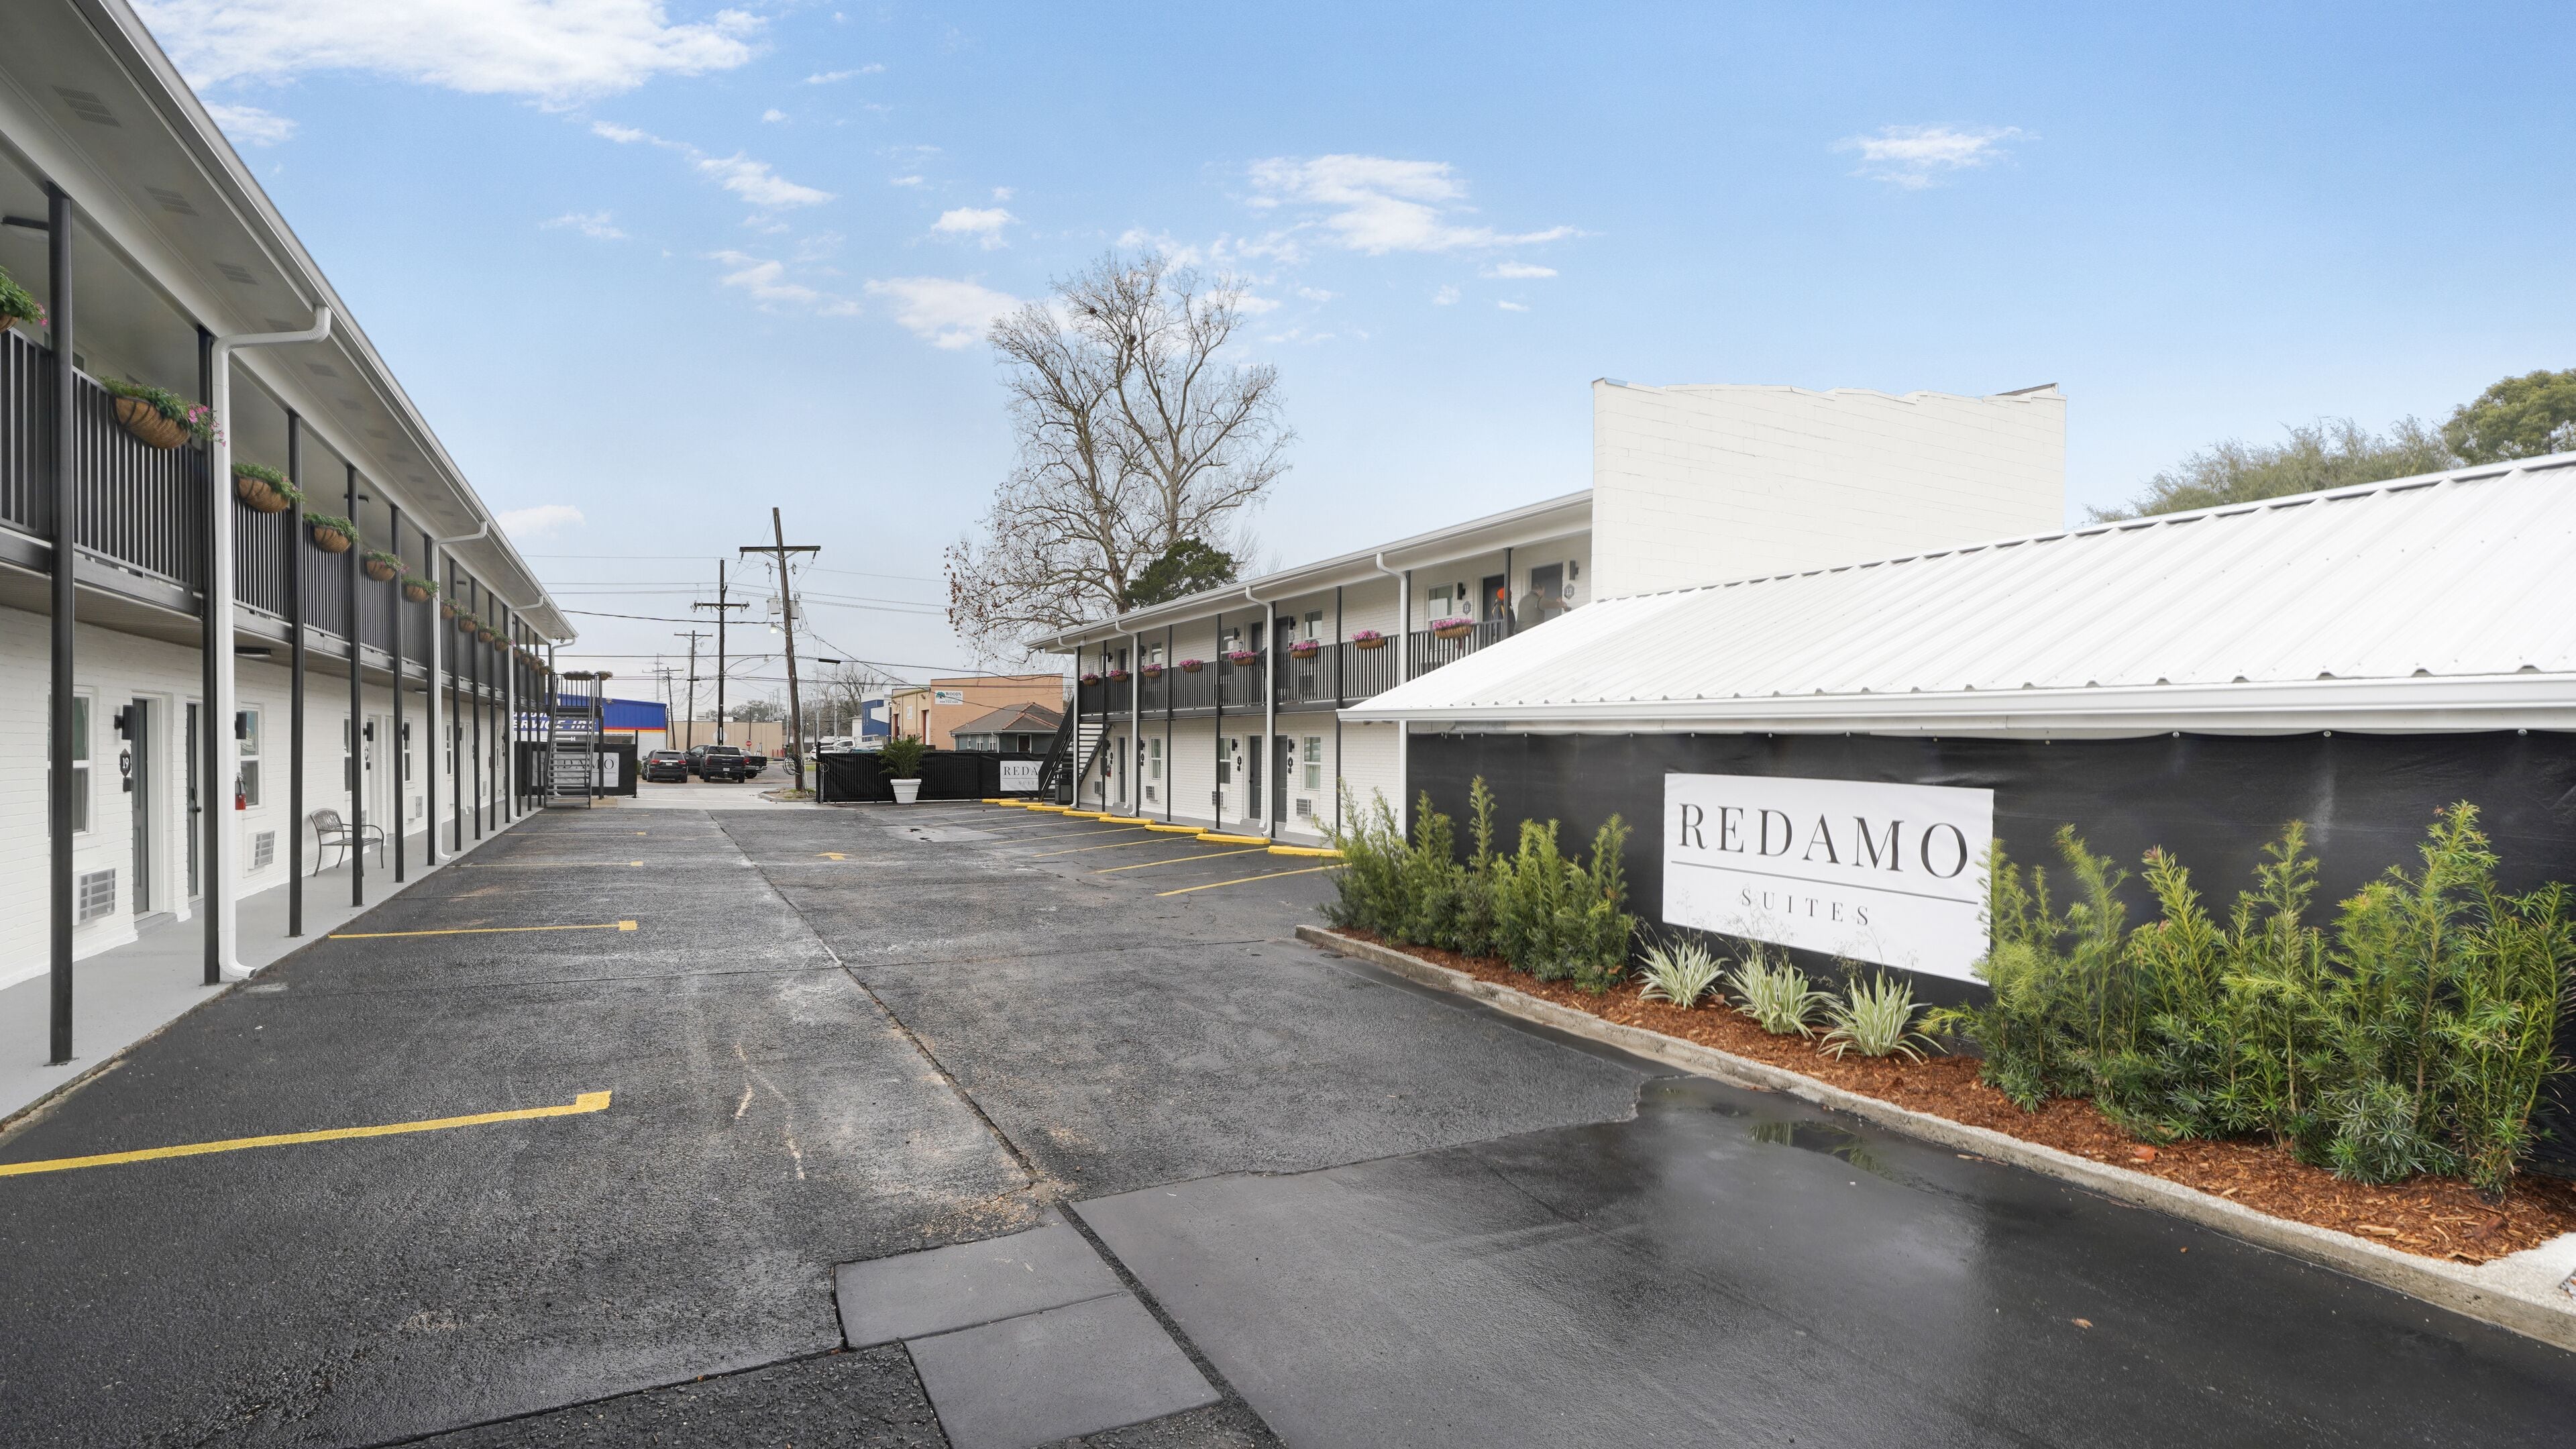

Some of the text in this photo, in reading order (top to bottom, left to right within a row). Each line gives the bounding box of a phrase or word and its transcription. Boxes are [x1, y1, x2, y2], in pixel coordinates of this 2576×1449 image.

[122, 757, 129, 769] 19
[1004, 766, 1038, 775] REDA
[1678, 802, 1968, 879] REDAMO
[1741, 888, 1870, 926] SUITES
